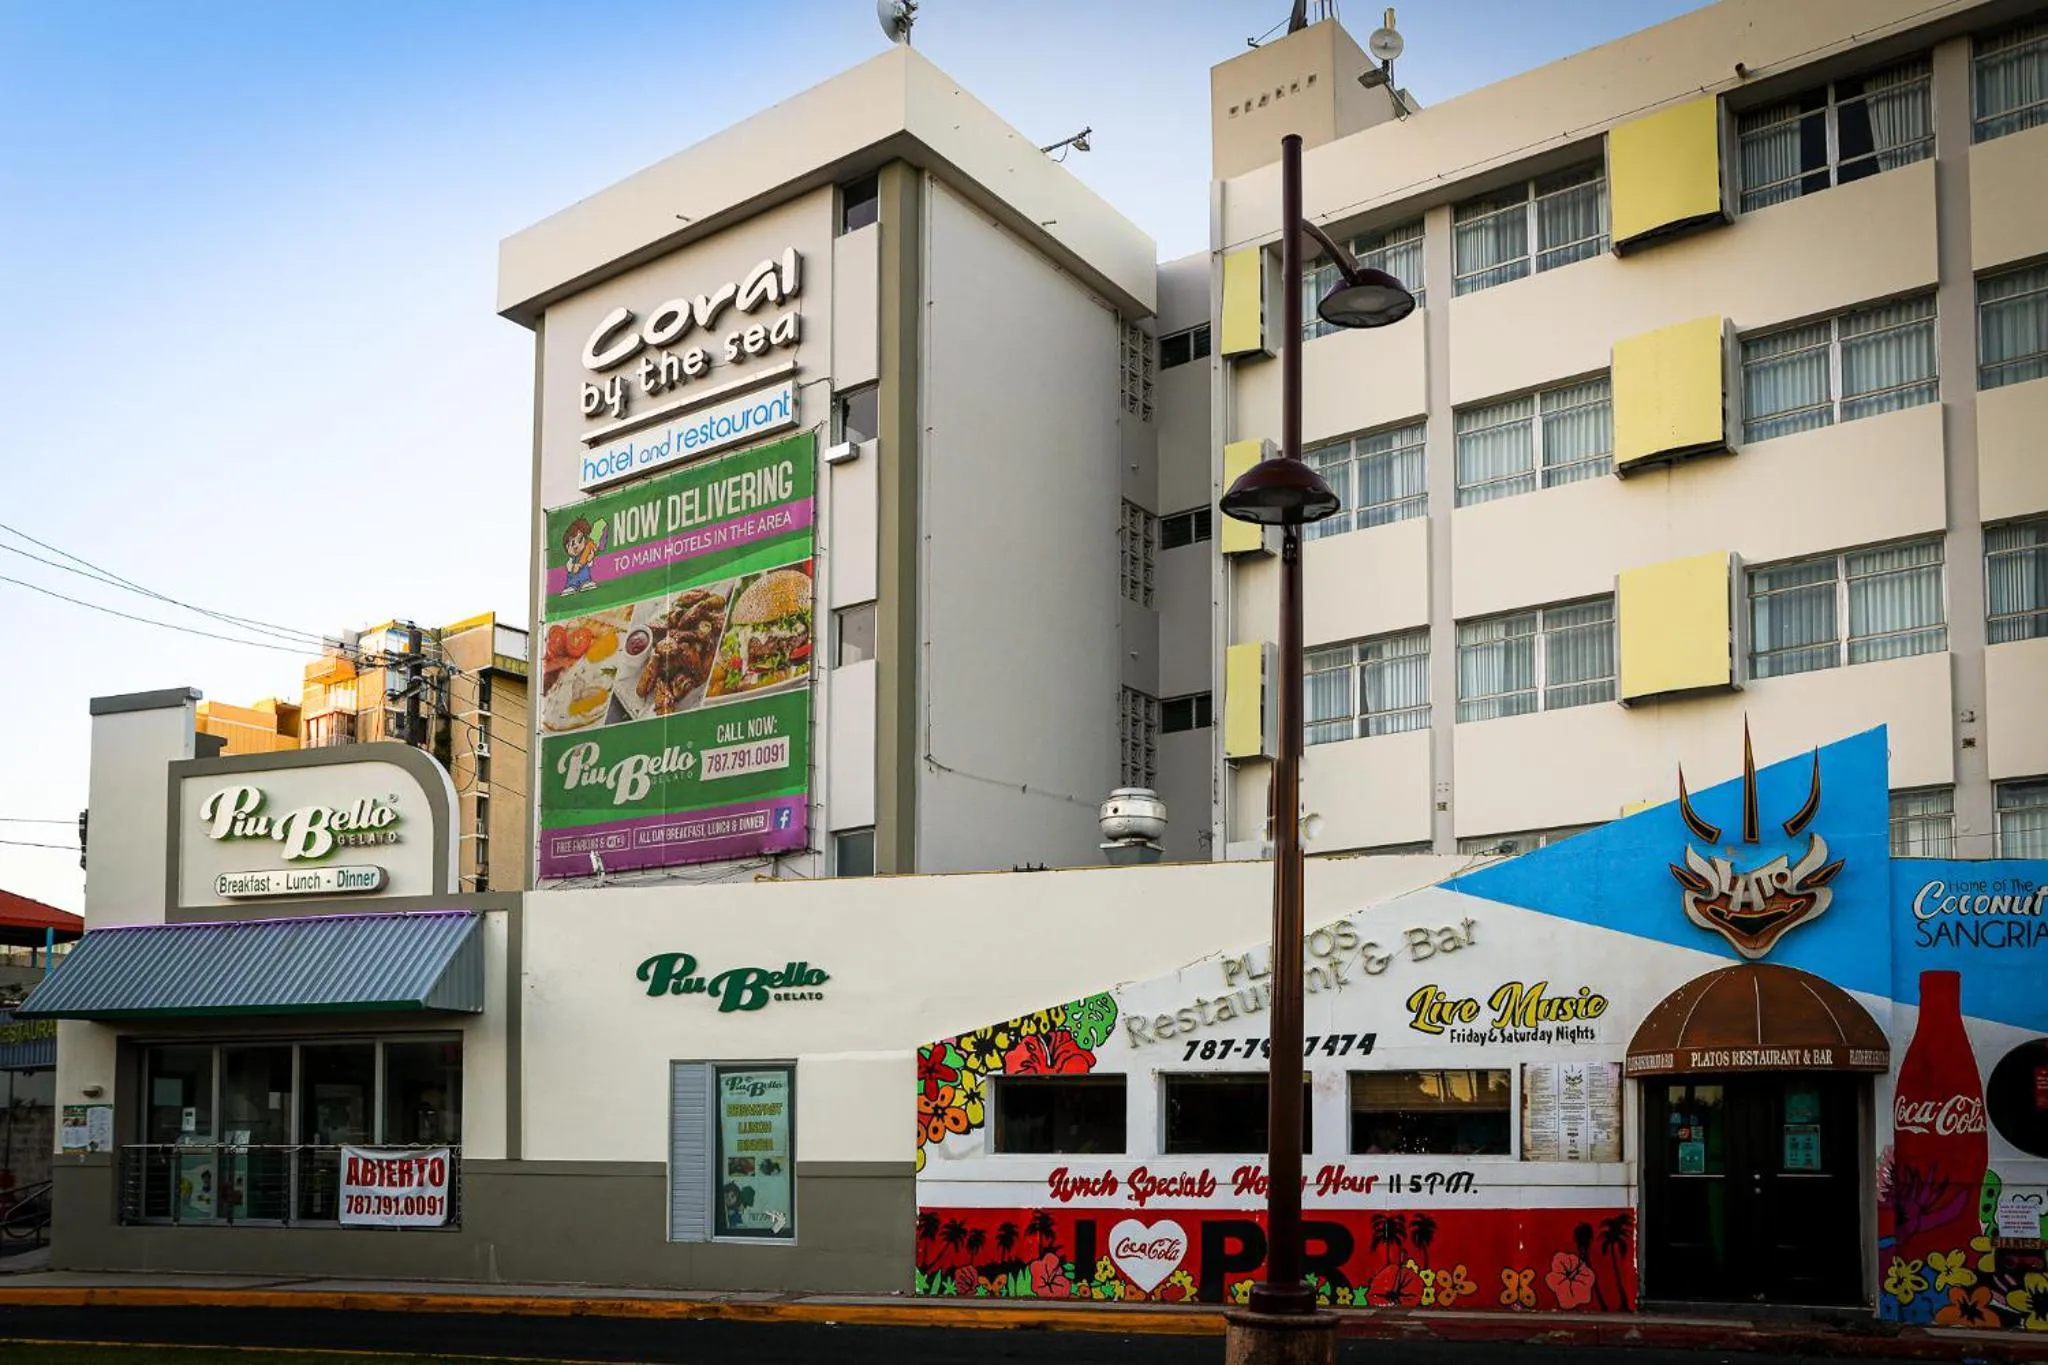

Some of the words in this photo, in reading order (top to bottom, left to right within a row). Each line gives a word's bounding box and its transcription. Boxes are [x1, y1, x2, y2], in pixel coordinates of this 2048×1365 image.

[582, 247, 803, 372] Coral
[580, 375, 629, 419] by
[637, 349, 712, 395] the
[724, 311, 802, 364] sea
[583, 444, 633, 482] hotel
[640, 431, 671, 464] and
[676, 390, 790, 450] restaurant
[614, 499, 661, 547] NOW
[667, 460, 793, 532] DELIVERING
[614, 555, 630, 572] TO
[632, 547, 661, 567] MAIN
[664, 532, 711, 559] HOTELS
[714, 528, 727, 543] IN
[730, 520, 754, 541] THE
[757, 511, 792, 533] AREA
[717, 723, 744, 743] CALL
[749, 716, 778, 738] NOW:
[557, 742, 607, 790] Piu
[606, 746, 697, 805] Bello
[707, 743, 785, 774] 787.791.0091
[200, 785, 270, 839] Piu
[271, 798, 400, 860] Bello
[338, 833, 397, 847] GELATO
[218, 873, 270, 894] Breakfast
[286, 872, 321, 890] Lunch
[336, 869, 376, 888] Dinner
[1949, 879, 1987, 893] Home
[1993, 880, 2006, 893] of
[2008, 878, 2033, 893] The
[1362, 941, 1393, 975] &
[1403, 917, 1477, 962] Bar
[1915, 920, 2048, 949] SANGRIA
[636, 952, 706, 997] Piu
[708, 961, 830, 1013] Bello
[774, 992, 823, 1001] GELATO
[1406, 984, 1481, 1036] Live
[1488, 981, 1608, 1029] Music
[1450, 1028, 1486, 1046] Friday
[1500, 1027, 1552, 1044] Saturday
[1555, 1026, 1596, 1044] Nights
[1691, 1051, 1729, 1067] PLATOS
[1732, 1050, 1801, 1066] RESTAURANT
[1803, 1049, 1811, 1065] &
[1813, 1049, 1833, 1065] BAR
[346, 1157, 445, 1188] ABIERTO
[1127, 1166, 1217, 1207] Specials
[1315, 1164, 1379, 1197] Hour
[346, 1195, 445, 1216] 787.791.0091
